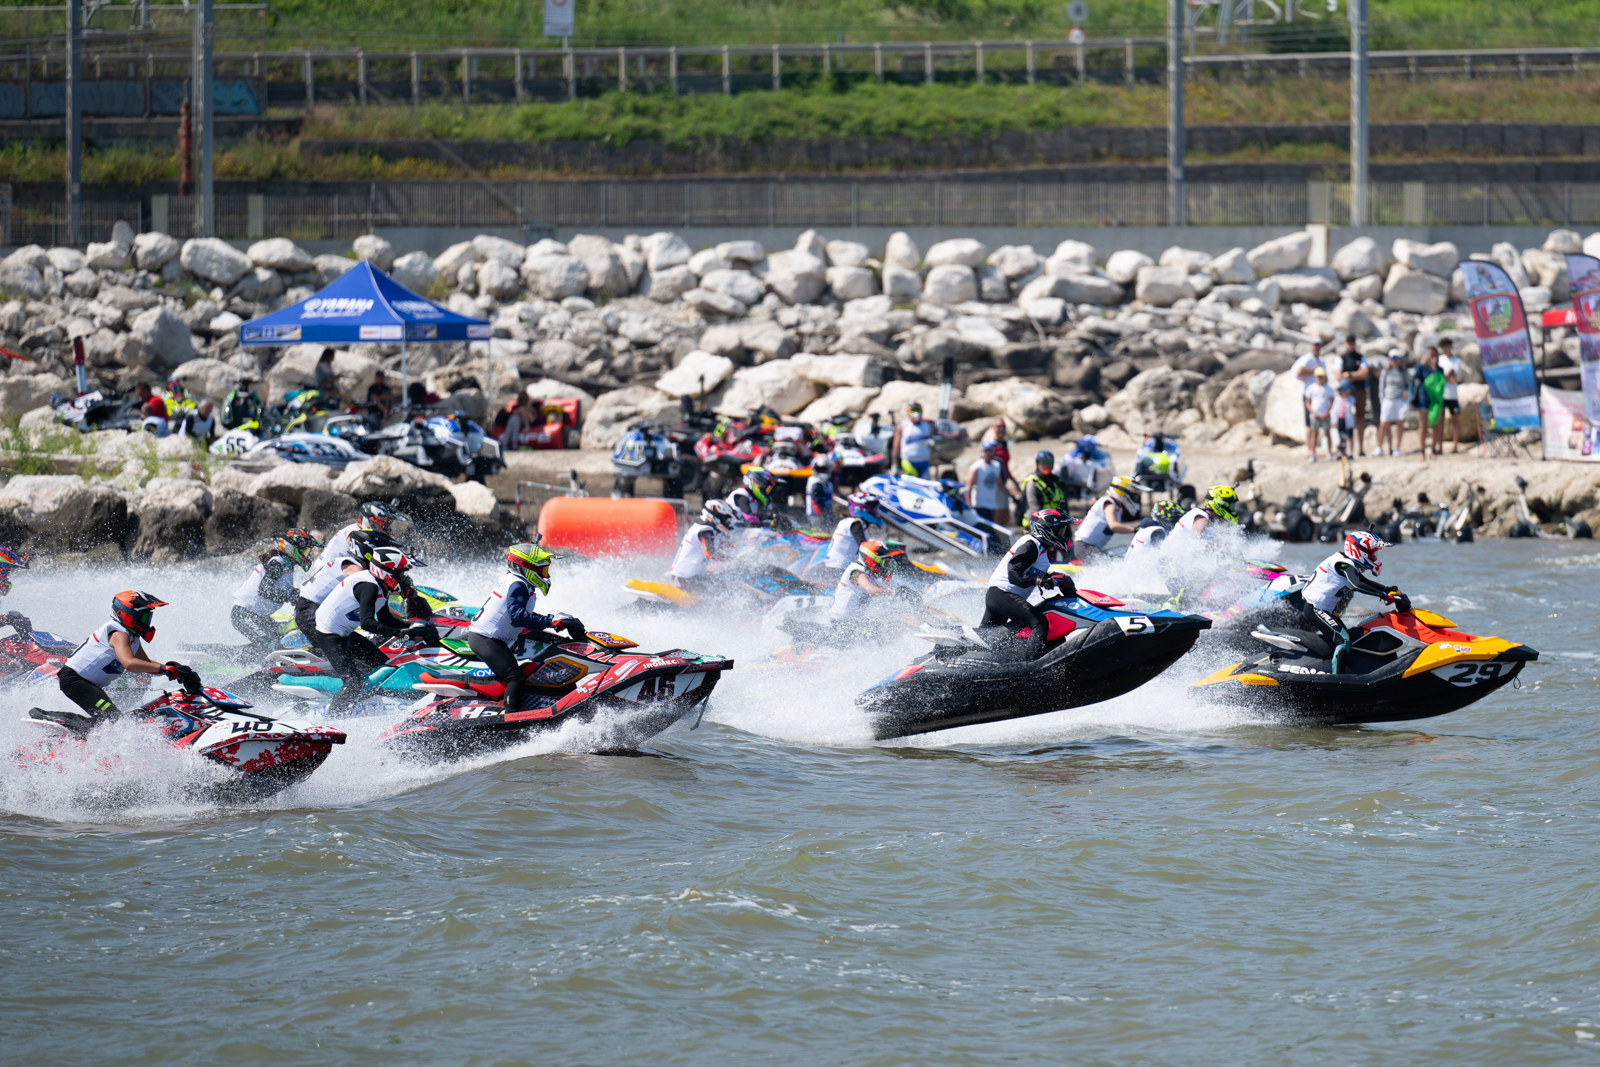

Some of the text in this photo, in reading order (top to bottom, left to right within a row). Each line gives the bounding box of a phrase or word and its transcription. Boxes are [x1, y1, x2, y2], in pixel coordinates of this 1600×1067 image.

[319, 298, 374, 311] YAMAHA
[1127, 616, 1147, 632] 5
[643, 659, 678, 669] IROMEC
[1447, 663, 1503, 683] 29
[636, 675, 676, 702] 46
[231, 721, 274, 733] 40
